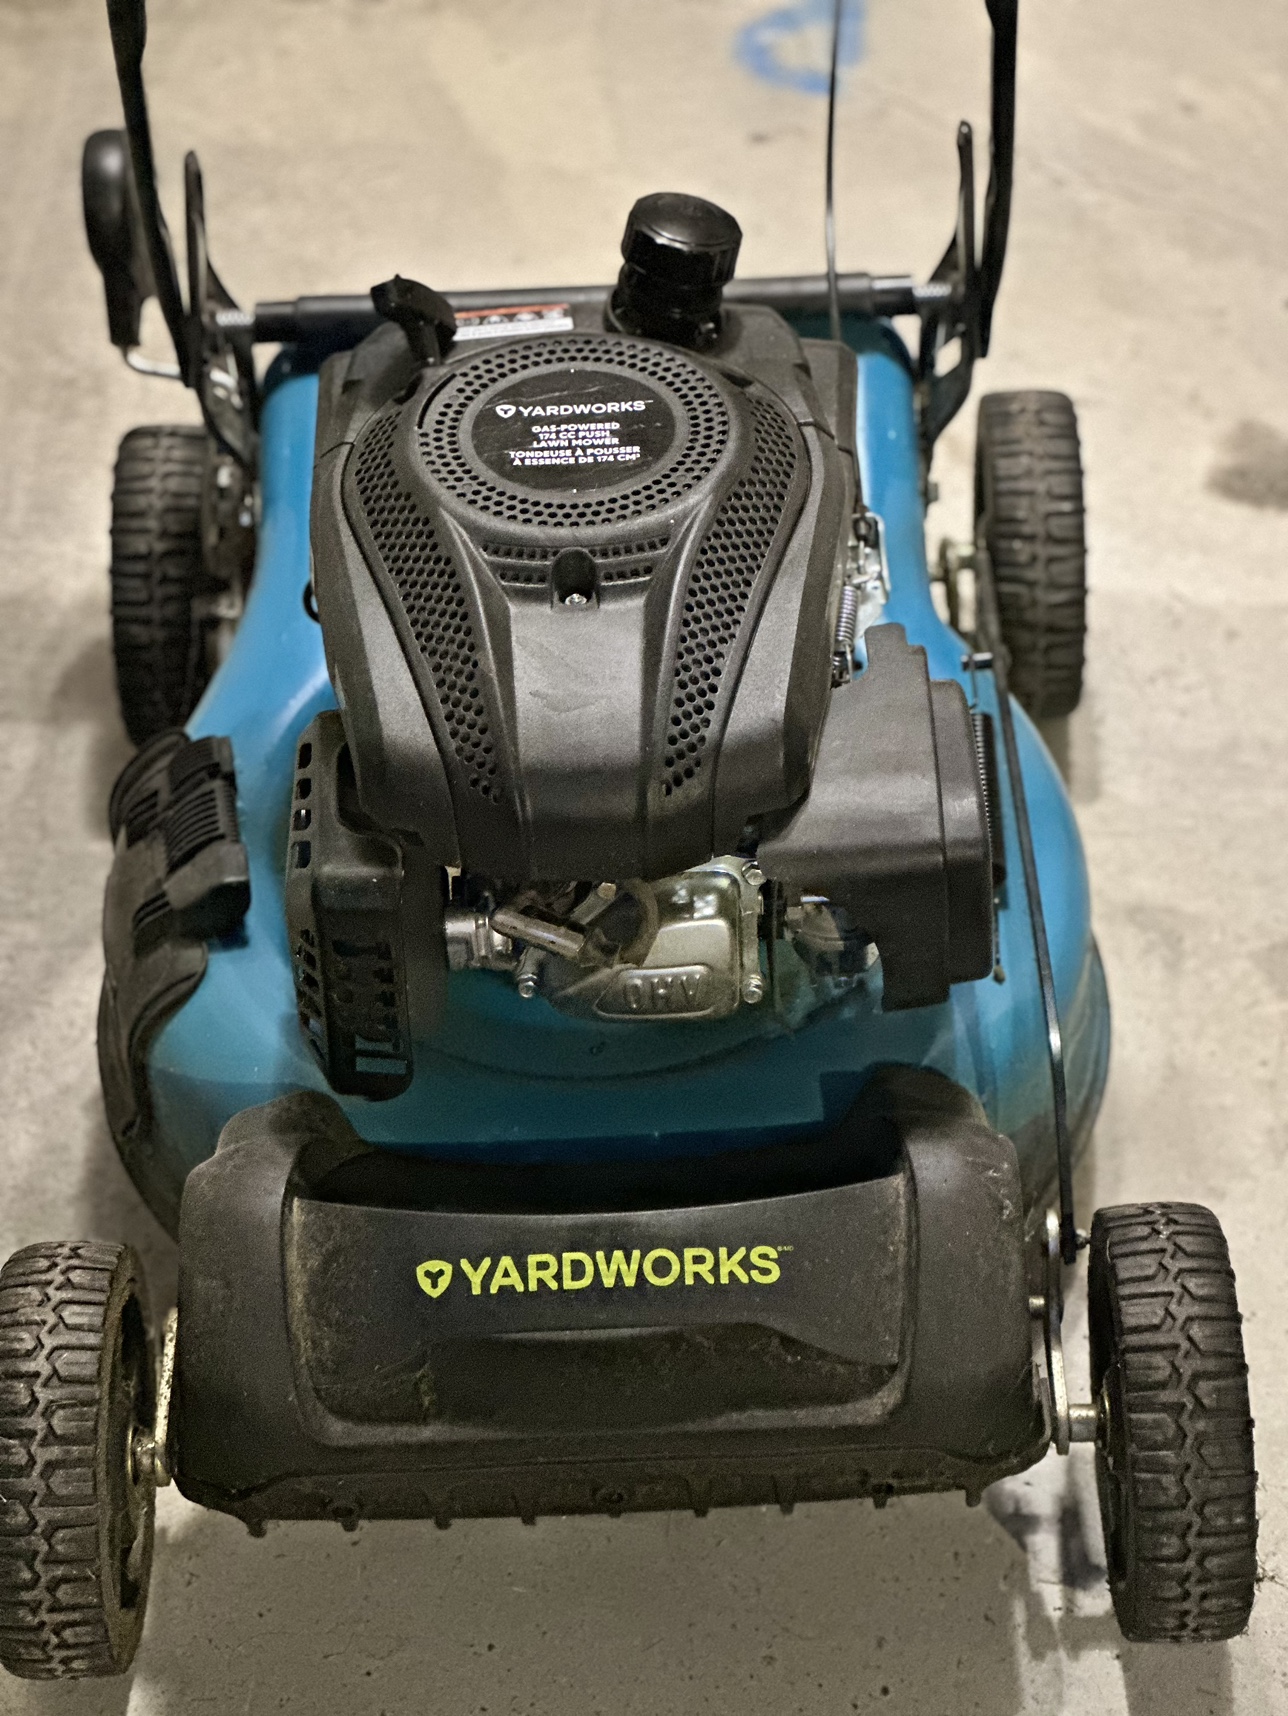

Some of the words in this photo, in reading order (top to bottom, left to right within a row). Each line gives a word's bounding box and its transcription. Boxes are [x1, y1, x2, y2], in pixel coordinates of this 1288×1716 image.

[518, 400, 646, 417] YARDWORKS
[531, 422, 620, 432] GAS-POWERED
[558, 431, 576, 439] CC
[578, 430, 610, 438] PUSH
[532, 440, 569, 448] LAWN
[571, 438, 620, 446] MOWER
[509, 449, 572, 459] TONDEUSE
[574, 447, 584, 456] À
[586, 445, 641, 456] POUSSER
[512, 457, 523, 466] À
[524, 456, 575, 466] ESSENCE
[578, 456, 594, 464] DE
[623, 976, 702, 1009] OHV
[459, 1245, 781, 1296] YARDWORKS
